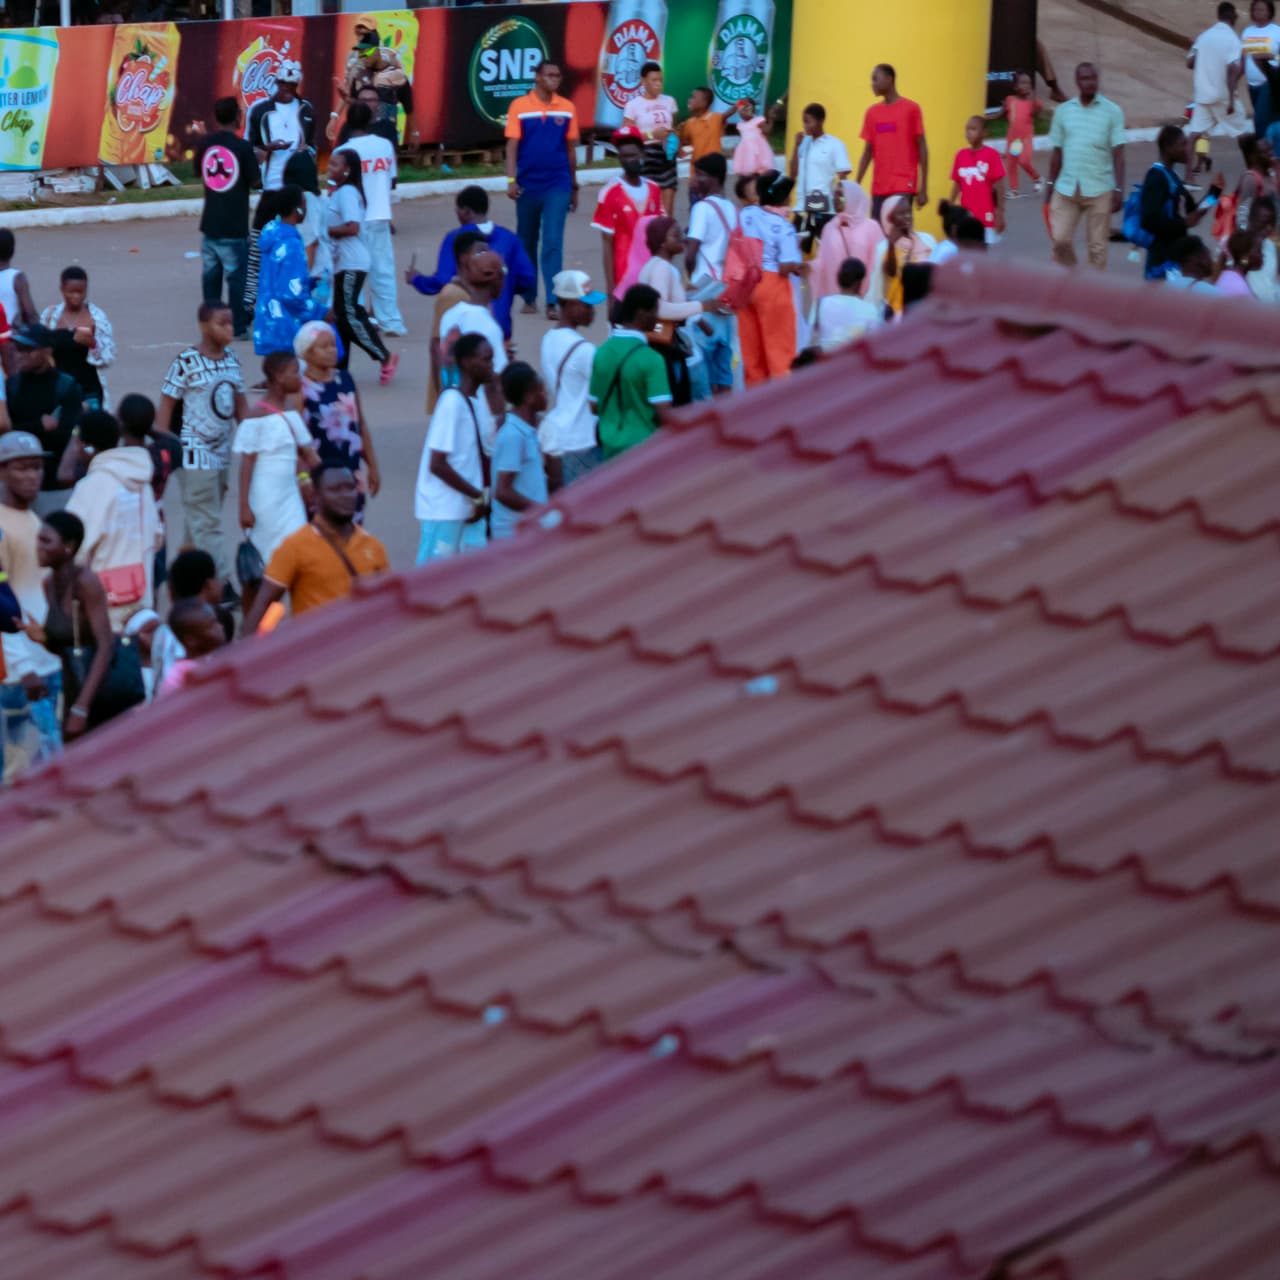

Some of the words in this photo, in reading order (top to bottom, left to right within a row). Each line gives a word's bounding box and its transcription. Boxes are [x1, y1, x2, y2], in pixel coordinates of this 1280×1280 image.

[613, 26, 656, 53] DJAMA
[719, 20, 764, 46] DJAMA
[242, 60, 278, 96] Cha
[479, 47, 542, 82] SNB
[116, 71, 166, 113] Chap
[718, 82, 756, 102] LAGER
[1, 108, 34, 137] Chap
